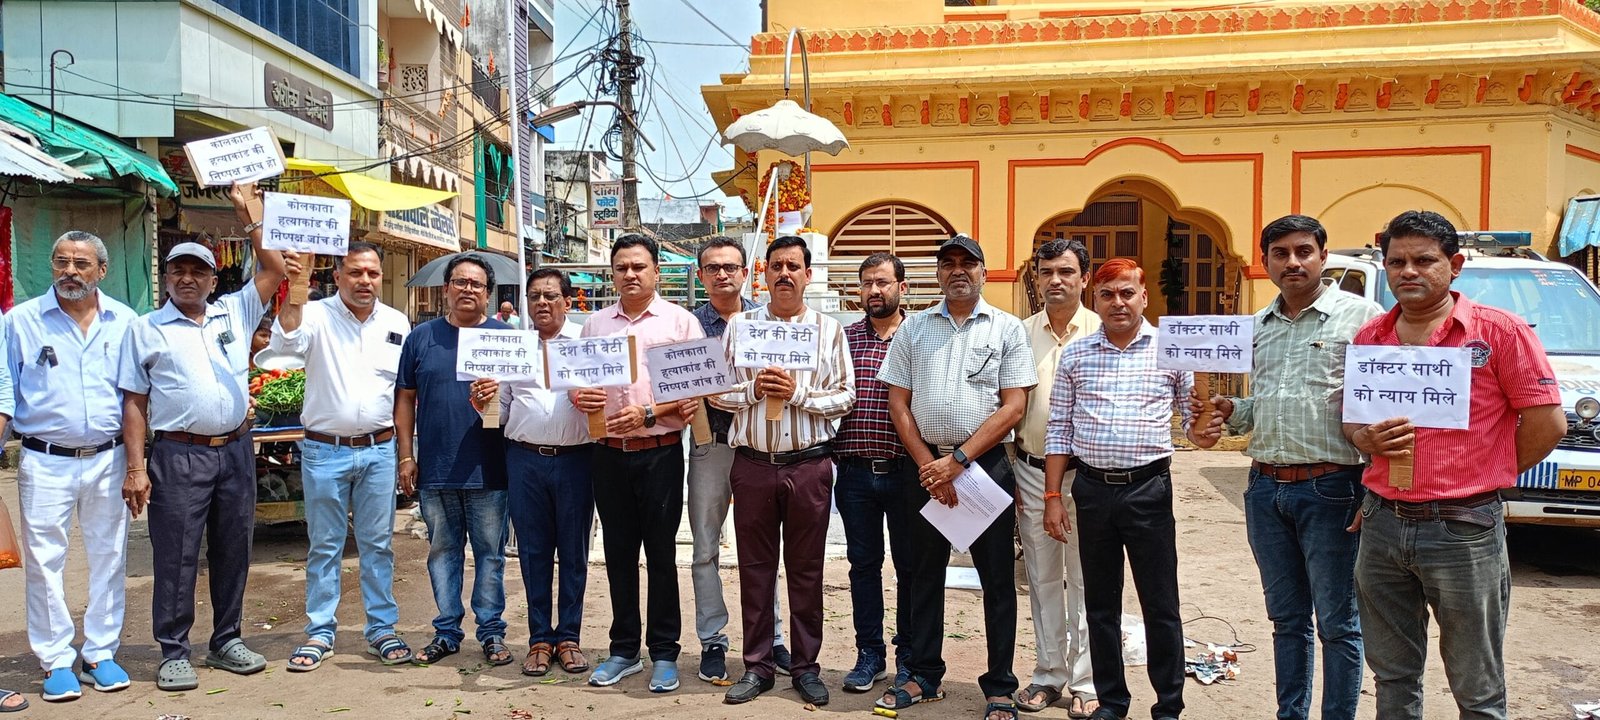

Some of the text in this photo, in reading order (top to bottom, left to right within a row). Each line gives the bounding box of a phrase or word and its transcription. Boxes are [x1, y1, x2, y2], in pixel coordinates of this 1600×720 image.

[272, 77, 300, 111] अशोक
[210, 133, 253, 148] कोलकाता
[209, 144, 265, 166] हत्याकांड की
[209, 157, 276, 180] निष्पक्ष जांच हो
[288, 199, 334, 213] कोलकाता
[596, 197, 618, 207] फोटो
[594, 208, 618, 220] स्टूडियो
[278, 216, 339, 229] हत्याकांड की
[270, 229, 344, 247] निष्पक्ष जांच हो
[749, 325, 813, 342] देश की बेटी
[1169, 321, 1240, 335] डॉक्टर साथी
[480, 332, 522, 343] कोलकाता
[472, 348, 527, 359] हत्याकांड की
[559, 339, 622, 357] देश की बेटी
[664, 346, 707, 360] कोलकाता
[1165, 344, 1242, 360] को न्याय मिले
[744, 349, 811, 364] को न्याय मिले
[464, 361, 532, 375] निष्पक्ष जांच हो
[557, 363, 624, 379] को न्याय मिले
[661, 358, 715, 379] हत्याकांड की
[1358, 358, 1452, 376] डॉक्टर साथी
[659, 373, 725, 393] निष्पक्ष जांच हो
[1354, 385, 1457, 405] को न्याय मिले
[1565, 475, 1582, 487] MP
